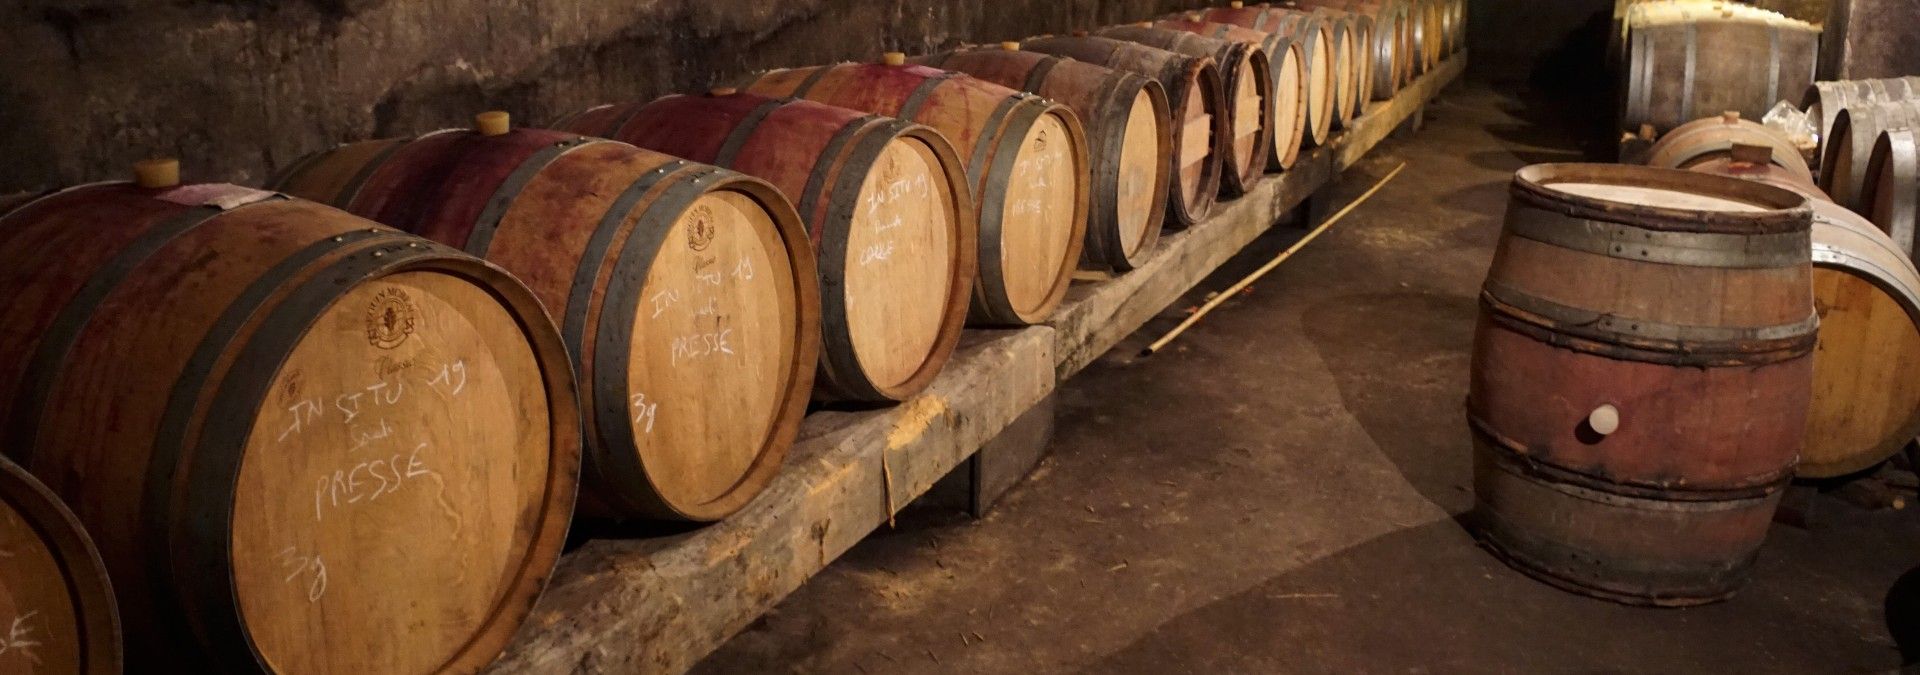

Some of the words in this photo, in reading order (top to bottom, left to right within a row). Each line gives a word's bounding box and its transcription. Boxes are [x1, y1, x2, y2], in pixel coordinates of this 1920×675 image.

[651, 289, 678, 319] IN
[671, 328, 734, 368] PRESSE
[279, 398, 323, 442] IN
[426, 359, 466, 396] 19
[316, 442, 431, 522] PRESSE
